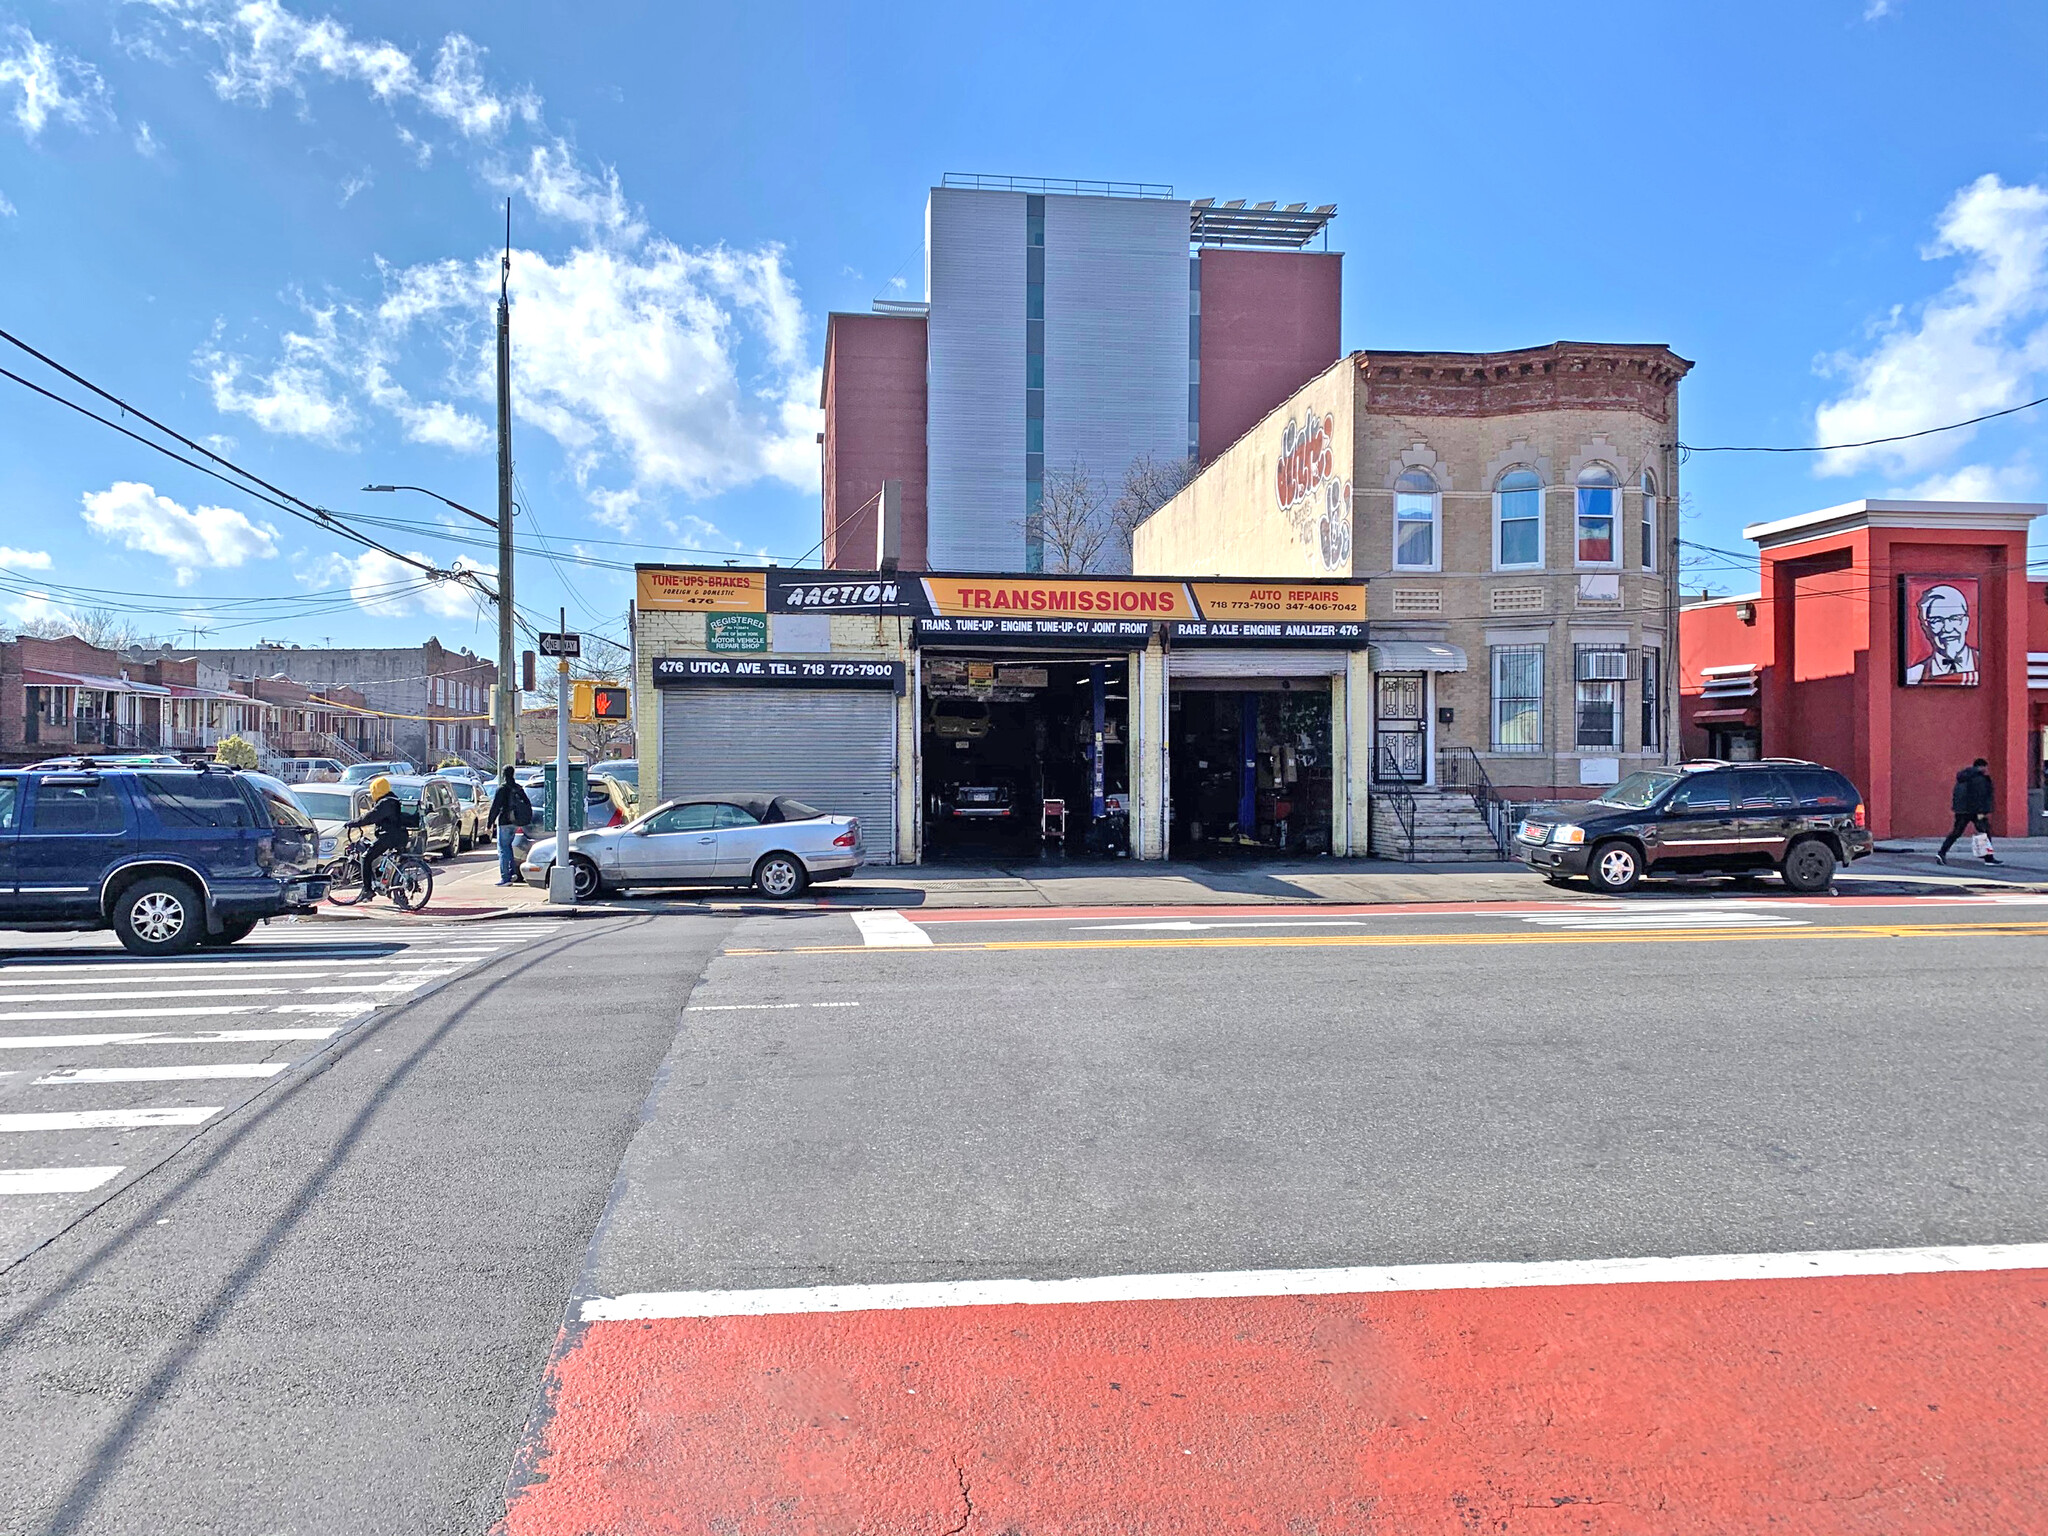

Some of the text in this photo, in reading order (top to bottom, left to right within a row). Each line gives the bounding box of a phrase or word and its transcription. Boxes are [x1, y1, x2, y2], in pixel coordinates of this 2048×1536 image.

[786, 584, 899, 606] AACTION
[958, 588, 1174, 612] TRANSMISSIONS
[1250, 590, 1339, 602] AUTO REPAIRS
[1210, 601, 1357, 611] 718 773-7900 347-406-7042
[710, 616, 765, 629] REGISTERED
[921, 619, 952, 631] TRANS.
[956, 619, 993, 632] TUNE-UP
[1001, 620, 1032, 632] ENGINE
[1091, 621, 1116, 634] JOINT
[1119, 622, 1148, 634] FRONT
[1178, 623, 1207, 635] RARE
[545, 640, 557, 650] ONE
[659, 661, 892, 676] 476 UTICA AVE. TEL: 718 773-7900
